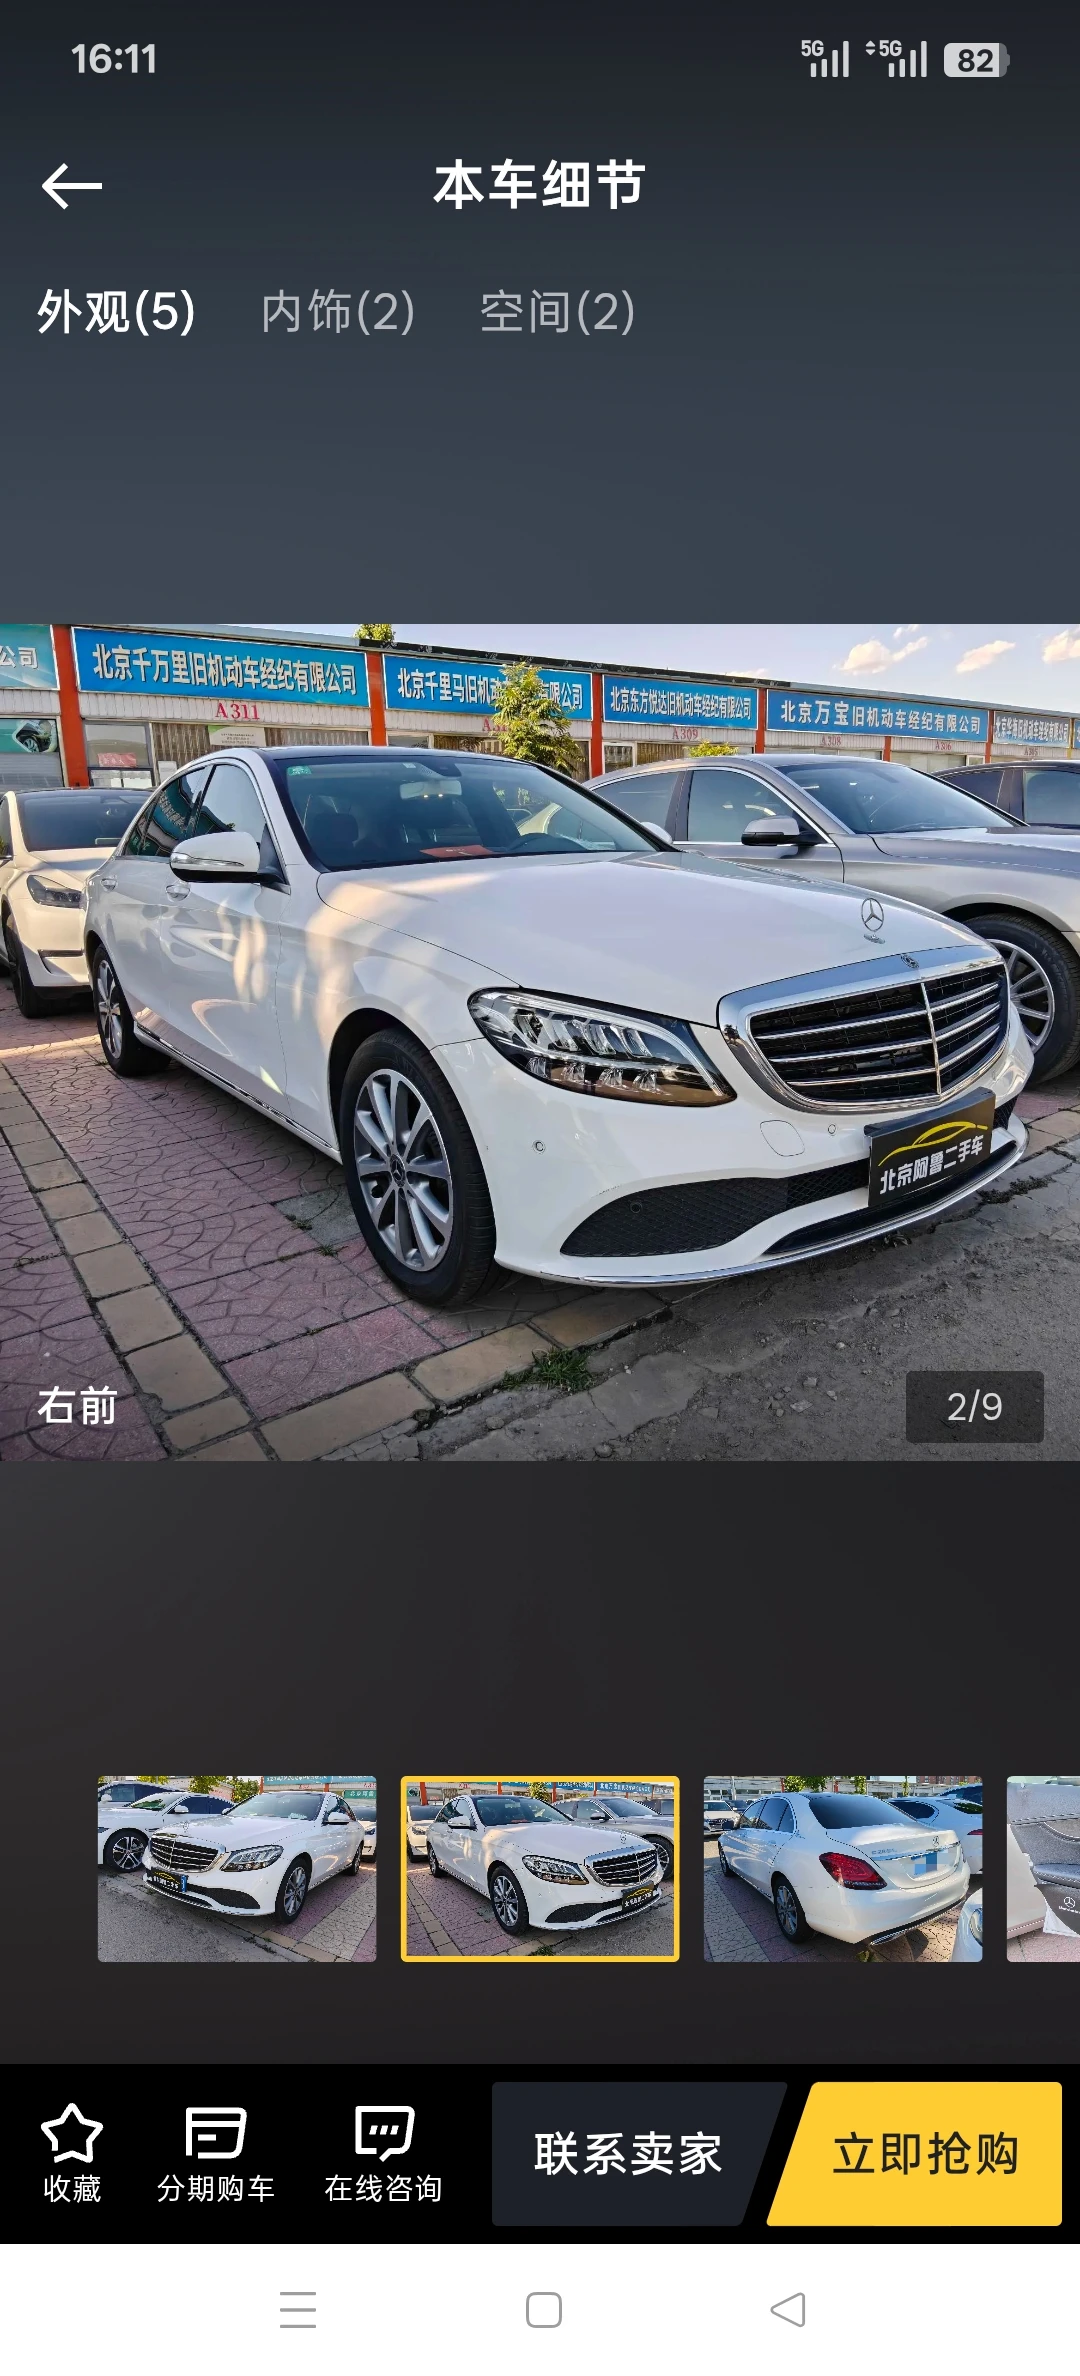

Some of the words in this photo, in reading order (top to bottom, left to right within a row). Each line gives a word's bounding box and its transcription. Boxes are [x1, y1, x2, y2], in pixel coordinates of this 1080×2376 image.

[71, 42, 156, 74] 16:11
[801, 39, 825, 57] 5G
[879, 39, 903, 57] 5G
[957, 48, 994, 73] 82
[432, 157, 646, 210] 本车细节
[36, 288, 195, 337] 外观(5)
[262, 288, 414, 336] 内饰(2)
[480, 288, 635, 336] 空间(2)
[92, 643, 357, 696] 北京千万里旧机动车经纪有限公司
[215, 702, 261, 720] A311
[610, 685, 752, 720] 北京东方悦达旧机动车经纪有限公司
[780, 699, 981, 735] 北京万宝旧机动车经纪有限公司
[672, 727, 698, 740] A309
[37, 1384, 118, 1425] 右前
[947, 1388, 1003, 1423] 2/9
[533, 2129, 724, 2177] 联系卖家
[831, 2130, 1019, 2177] 立即抢购
[43, 2173, 102, 2204] 收藏
[156, 2173, 275, 2204] 分期购车
[324, 2173, 443, 2204] 在线咨询
